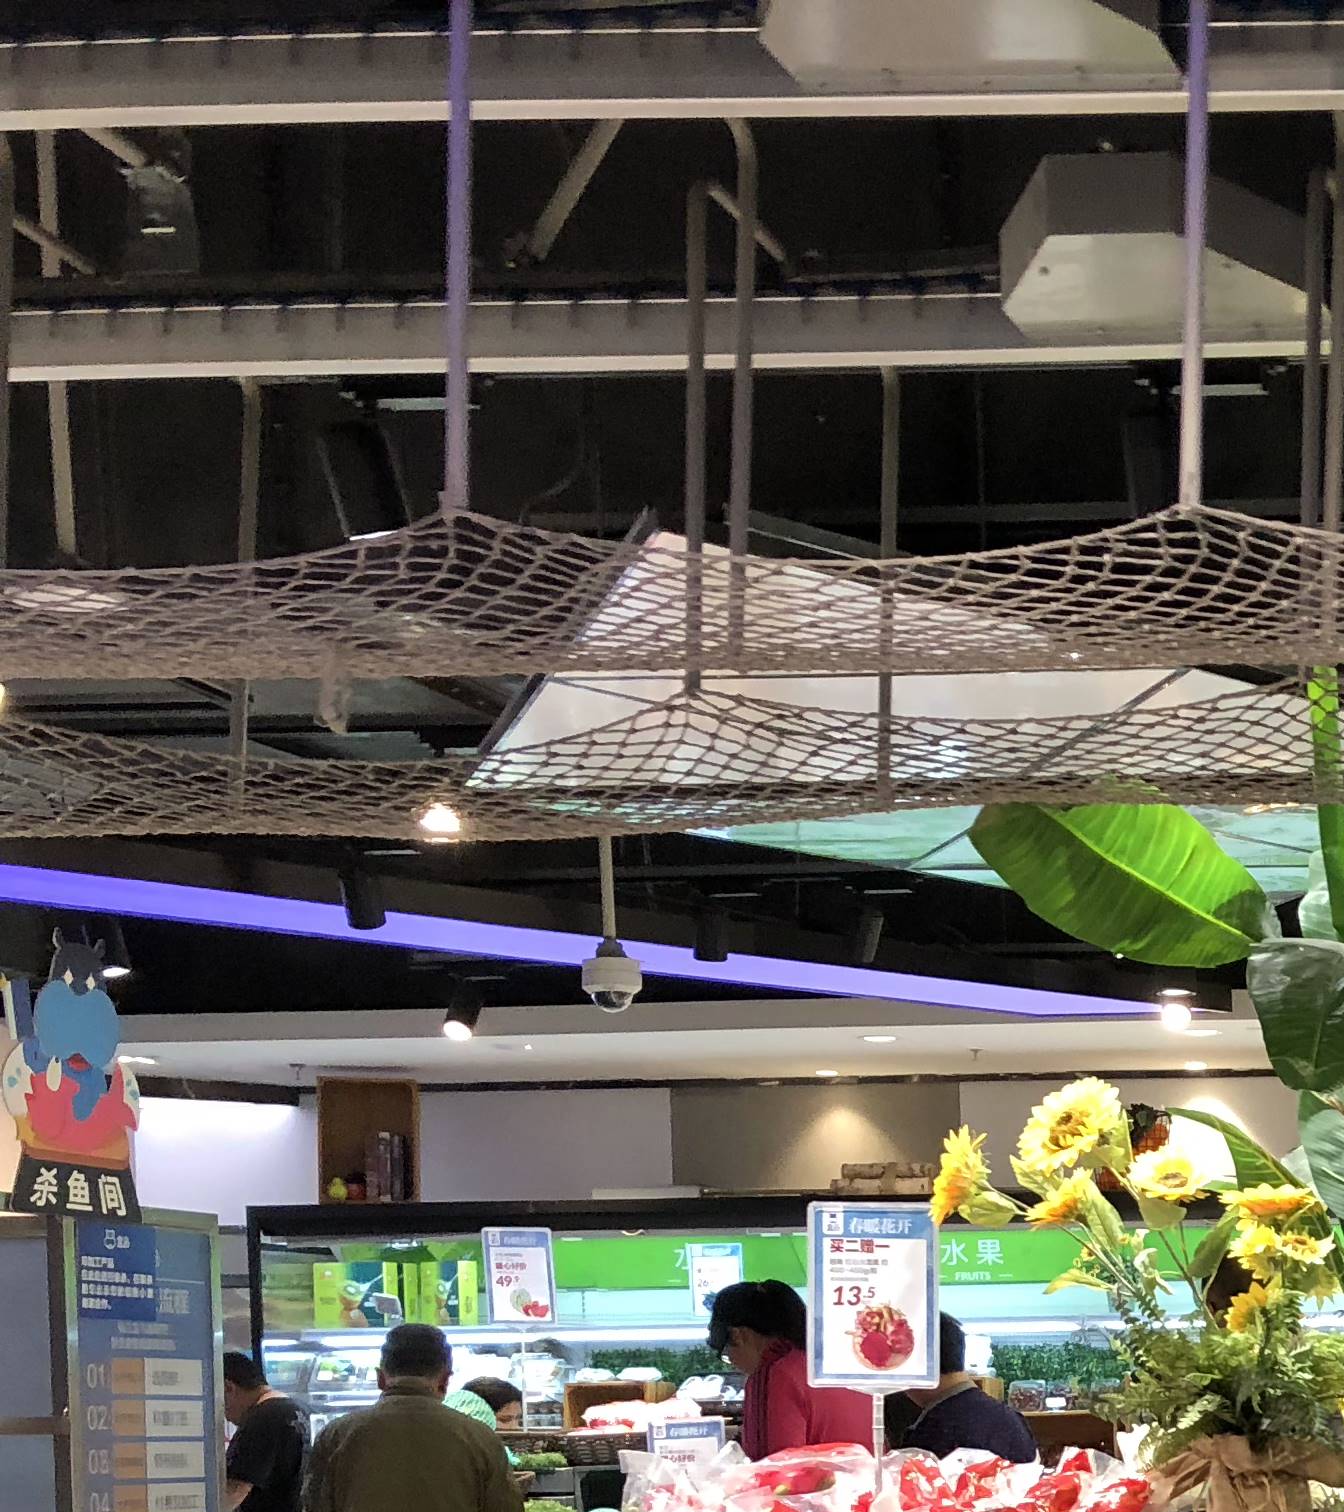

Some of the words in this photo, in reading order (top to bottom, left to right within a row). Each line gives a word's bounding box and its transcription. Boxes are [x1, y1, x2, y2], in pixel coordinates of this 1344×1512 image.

[30, 1167, 127, 1216] 杀鱼间
[850, 1218, 912, 1234] 春暖花开
[941, 1238, 1004, 1266] 水果
[955, 1272, 991, 1280] FRUITS
